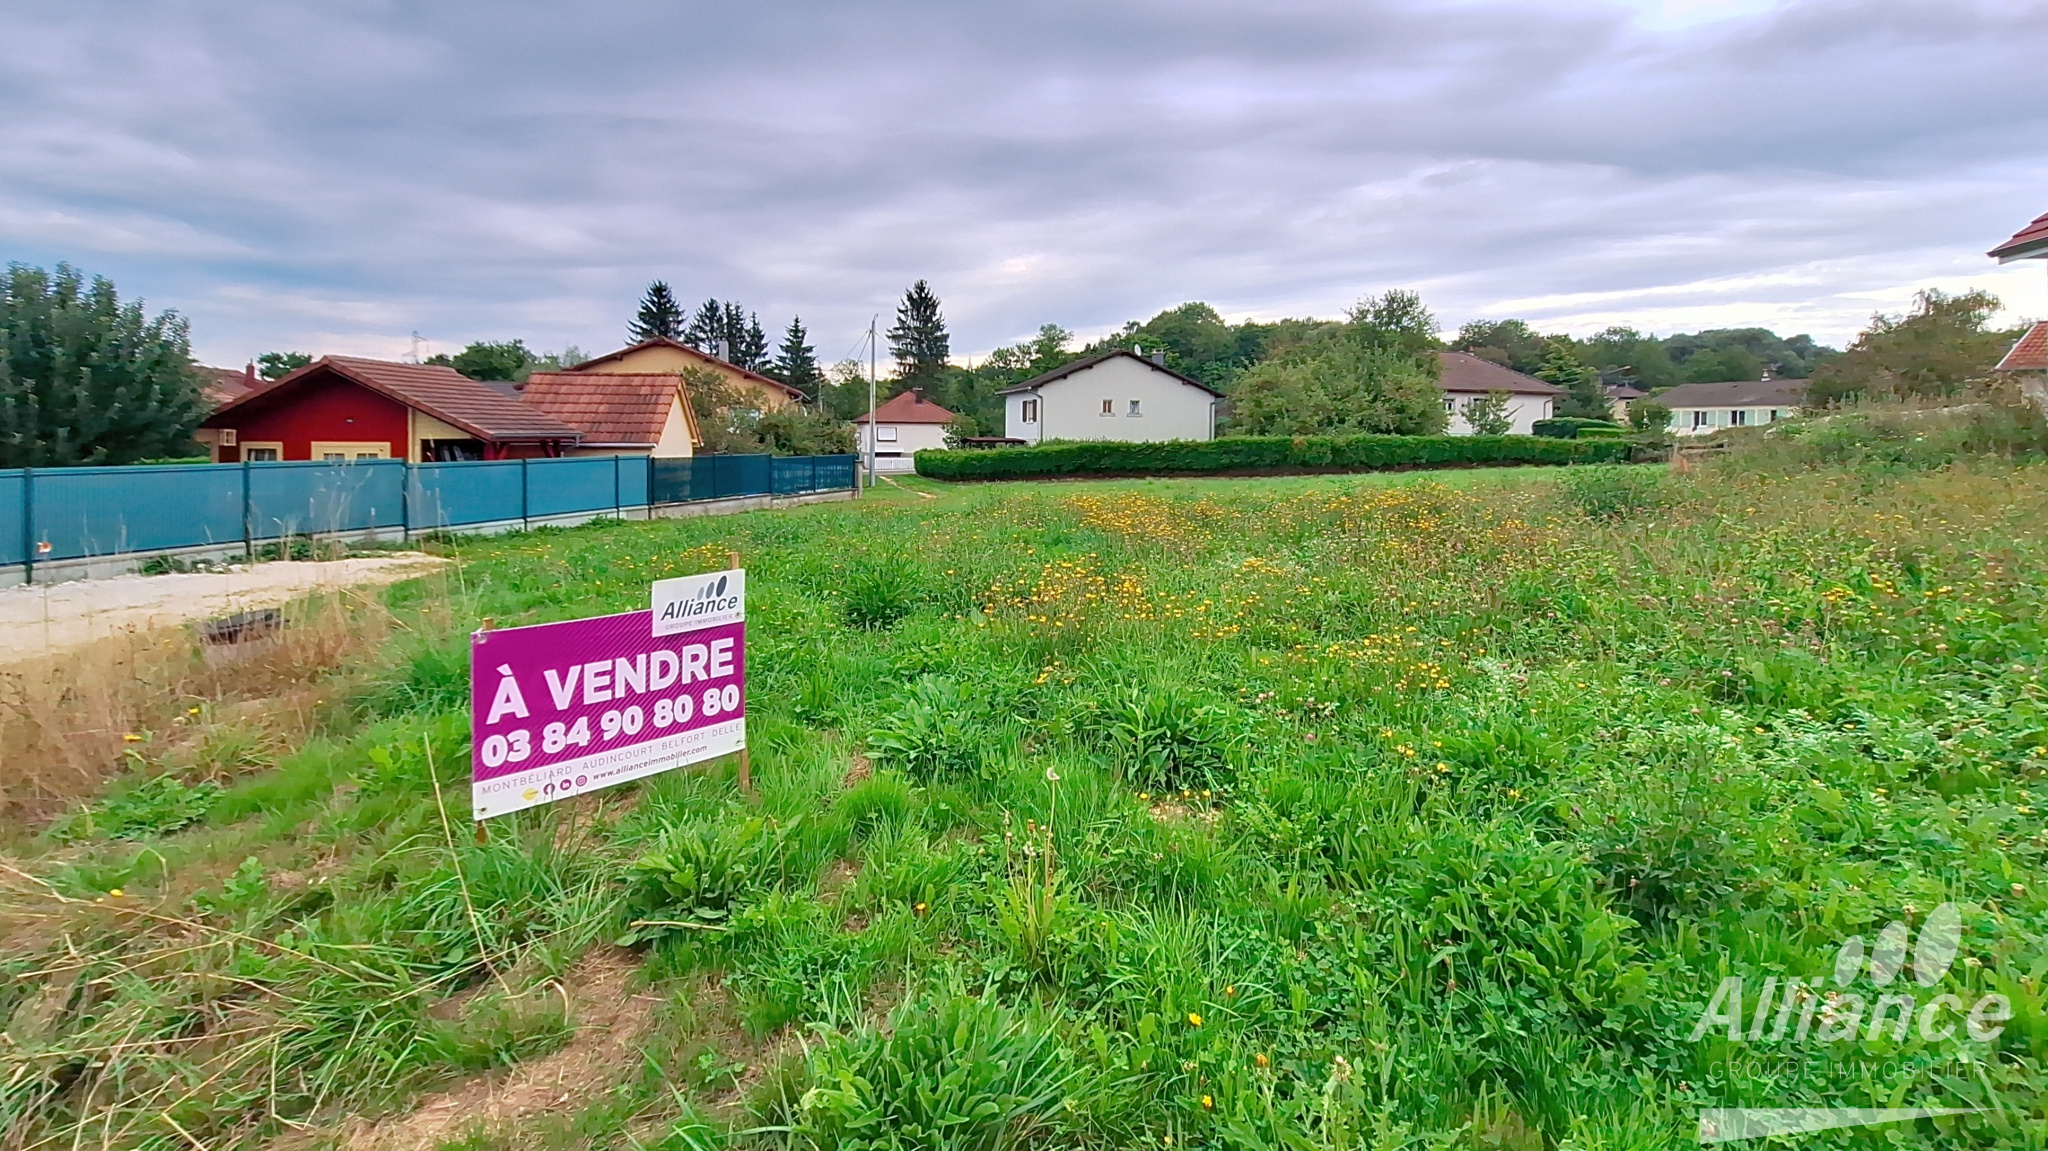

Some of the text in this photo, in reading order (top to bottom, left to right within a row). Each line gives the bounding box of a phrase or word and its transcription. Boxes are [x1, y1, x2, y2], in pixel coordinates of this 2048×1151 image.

[660, 596, 738, 621] Alliance
[665, 614, 733, 630] GROUPE IMMOBILIER
[486, 637, 735, 725] À VENDRE
[481, 684, 740, 768] 03 84 90 80 80
[482, 723, 740, 795] MONTBÉLIARD AUDINCOURT BELFORT DELLE
